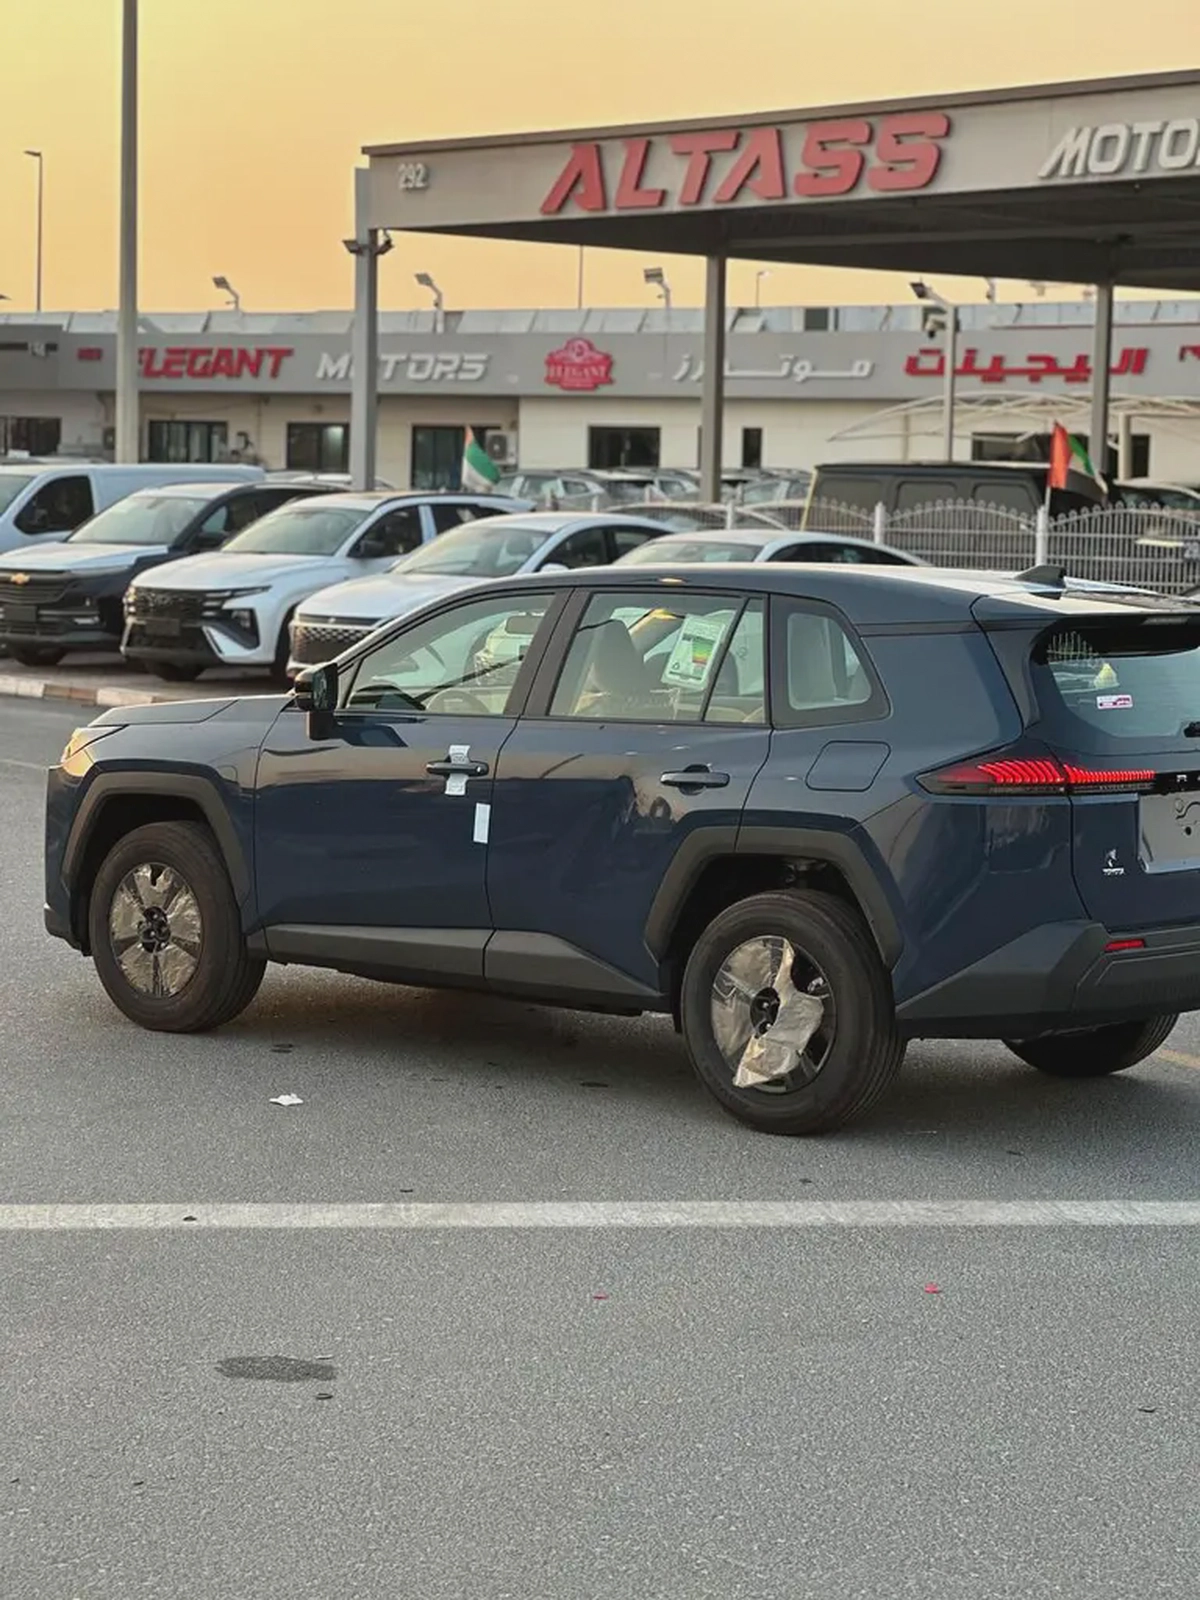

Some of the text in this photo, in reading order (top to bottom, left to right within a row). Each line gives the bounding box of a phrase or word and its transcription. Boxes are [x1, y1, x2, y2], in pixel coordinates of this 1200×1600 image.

[540, 112, 950, 215] ALTASS
[1037, 118, 1200, 178] MOTO
[398, 163, 426, 189] 292
[316, 352, 490, 380] MTORS
